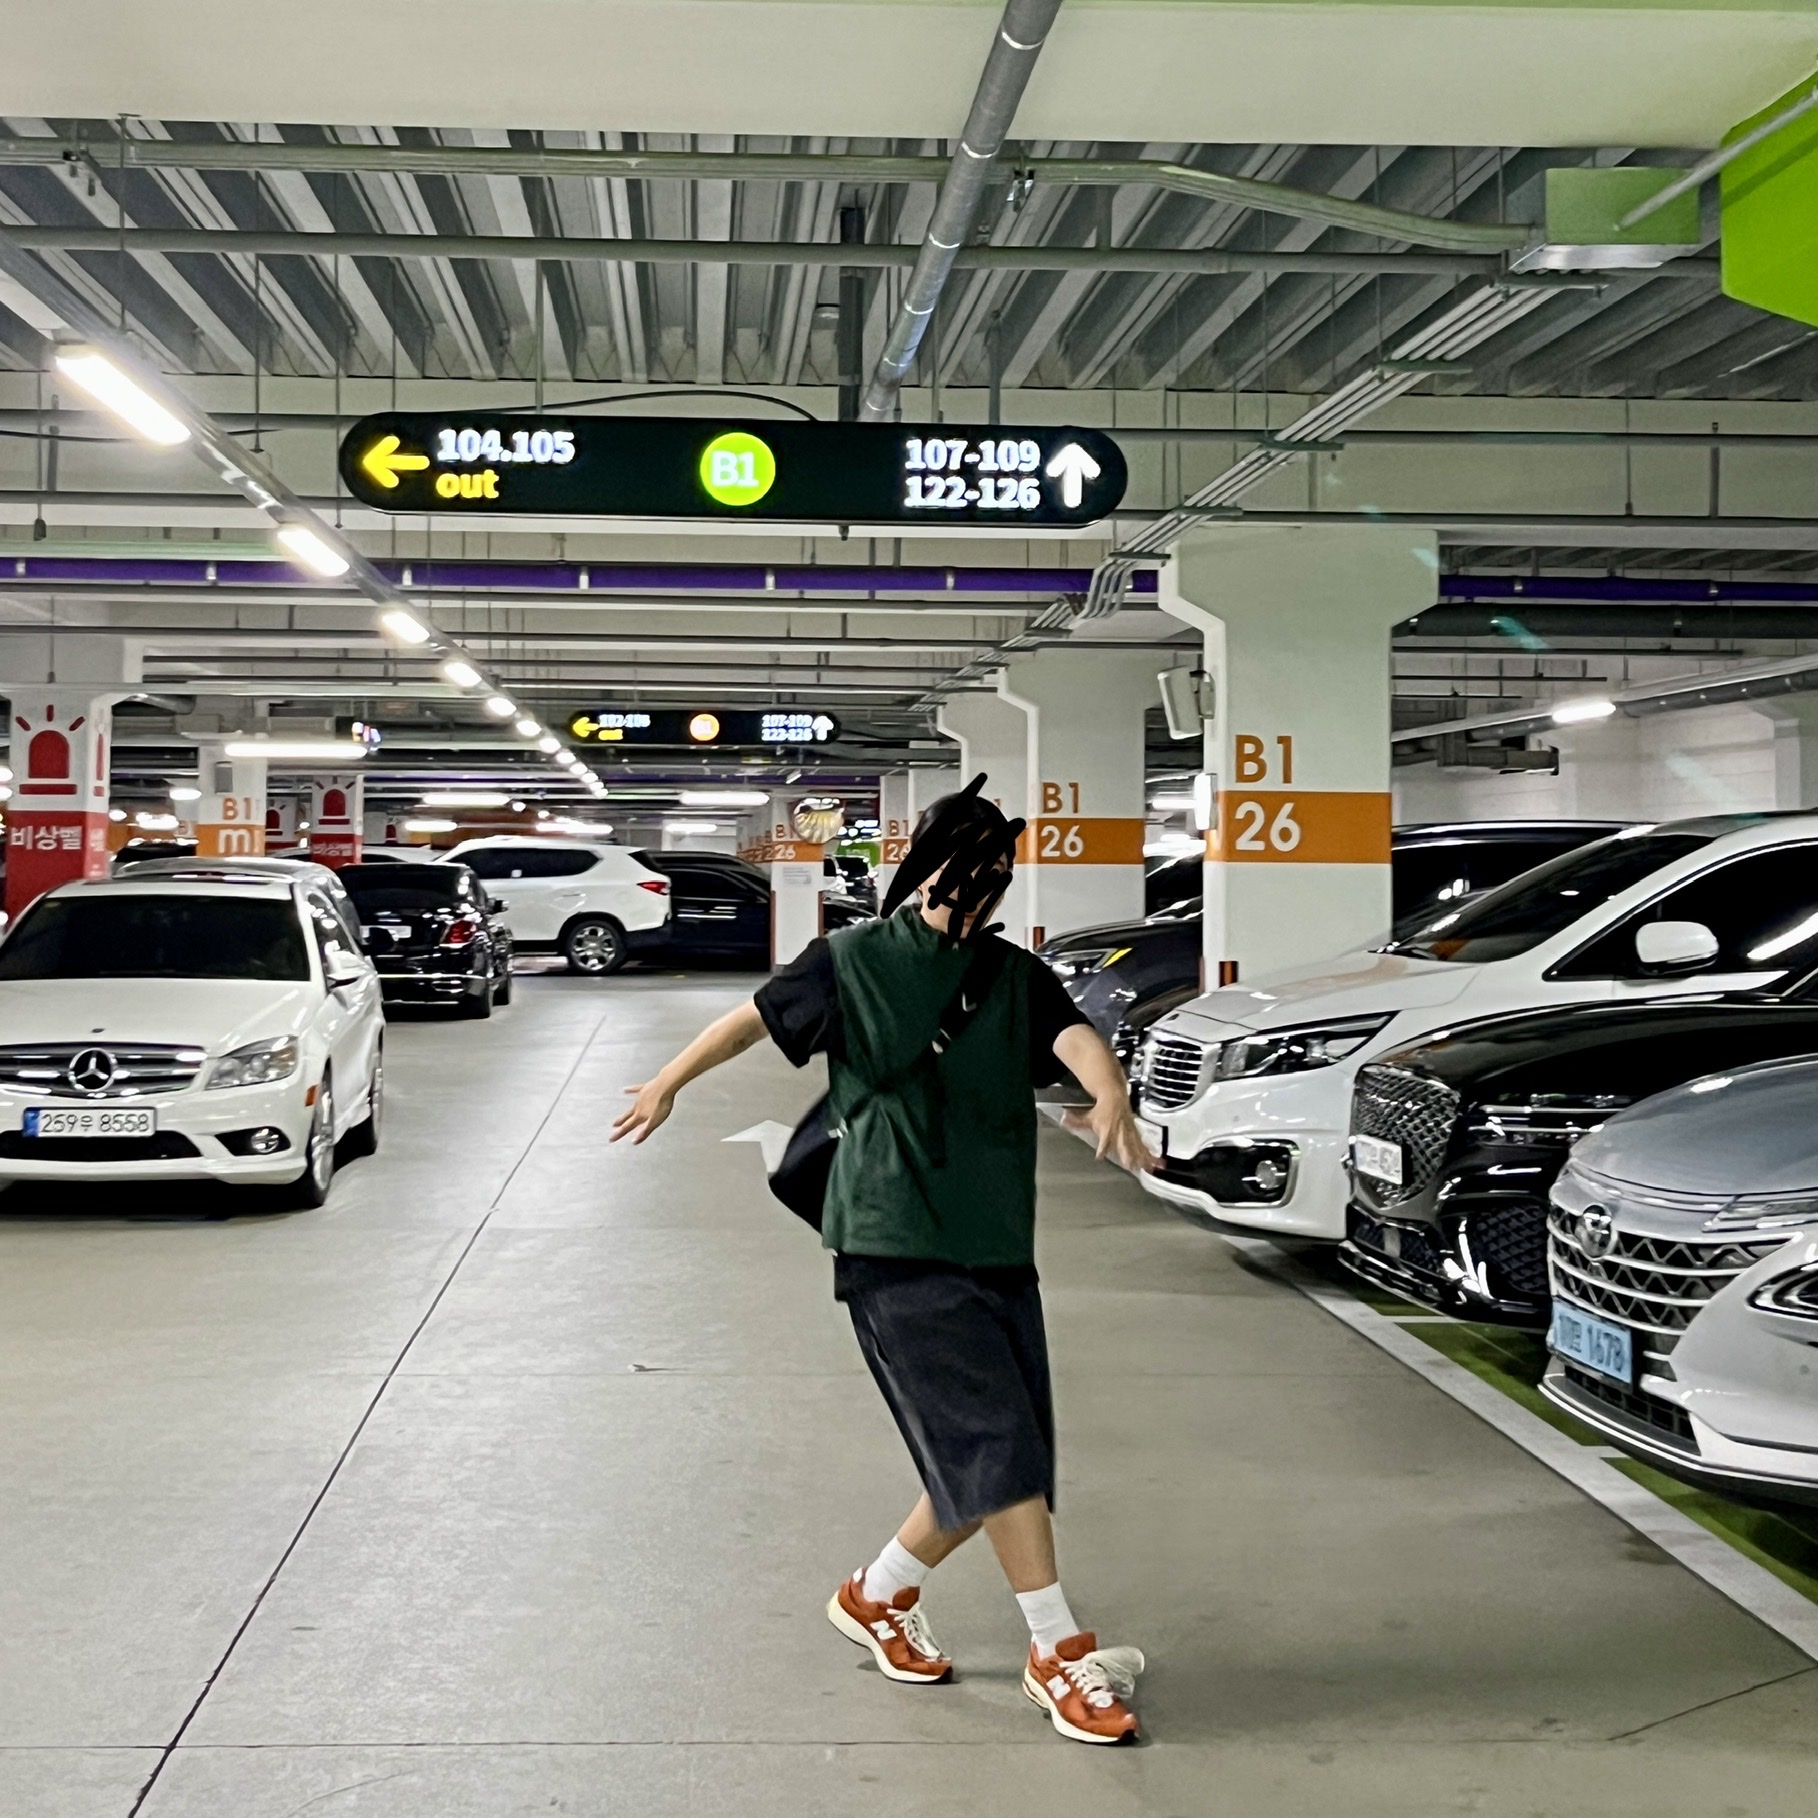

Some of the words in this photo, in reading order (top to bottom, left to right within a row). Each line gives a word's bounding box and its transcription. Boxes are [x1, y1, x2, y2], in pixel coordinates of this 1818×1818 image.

[437, 429, 576, 464] 104.105
[905, 439, 1041, 473] 107-109
[436, 469, 500, 499] out
[712, 451, 760, 487] B1
[905, 476, 1041, 510] 122-126
[1235, 734, 1293, 784] B1
[223, 797, 251, 820] B1
[1042, 782, 1079, 814] B1
[11, 825, 82, 850] 비상벨
[889, 819, 909, 836] B1
[1040, 824, 1083, 858] 26
[1234, 801, 1300, 851] 26
[774, 844, 797, 860] 26
[100, 1113, 150, 1133] 8558
